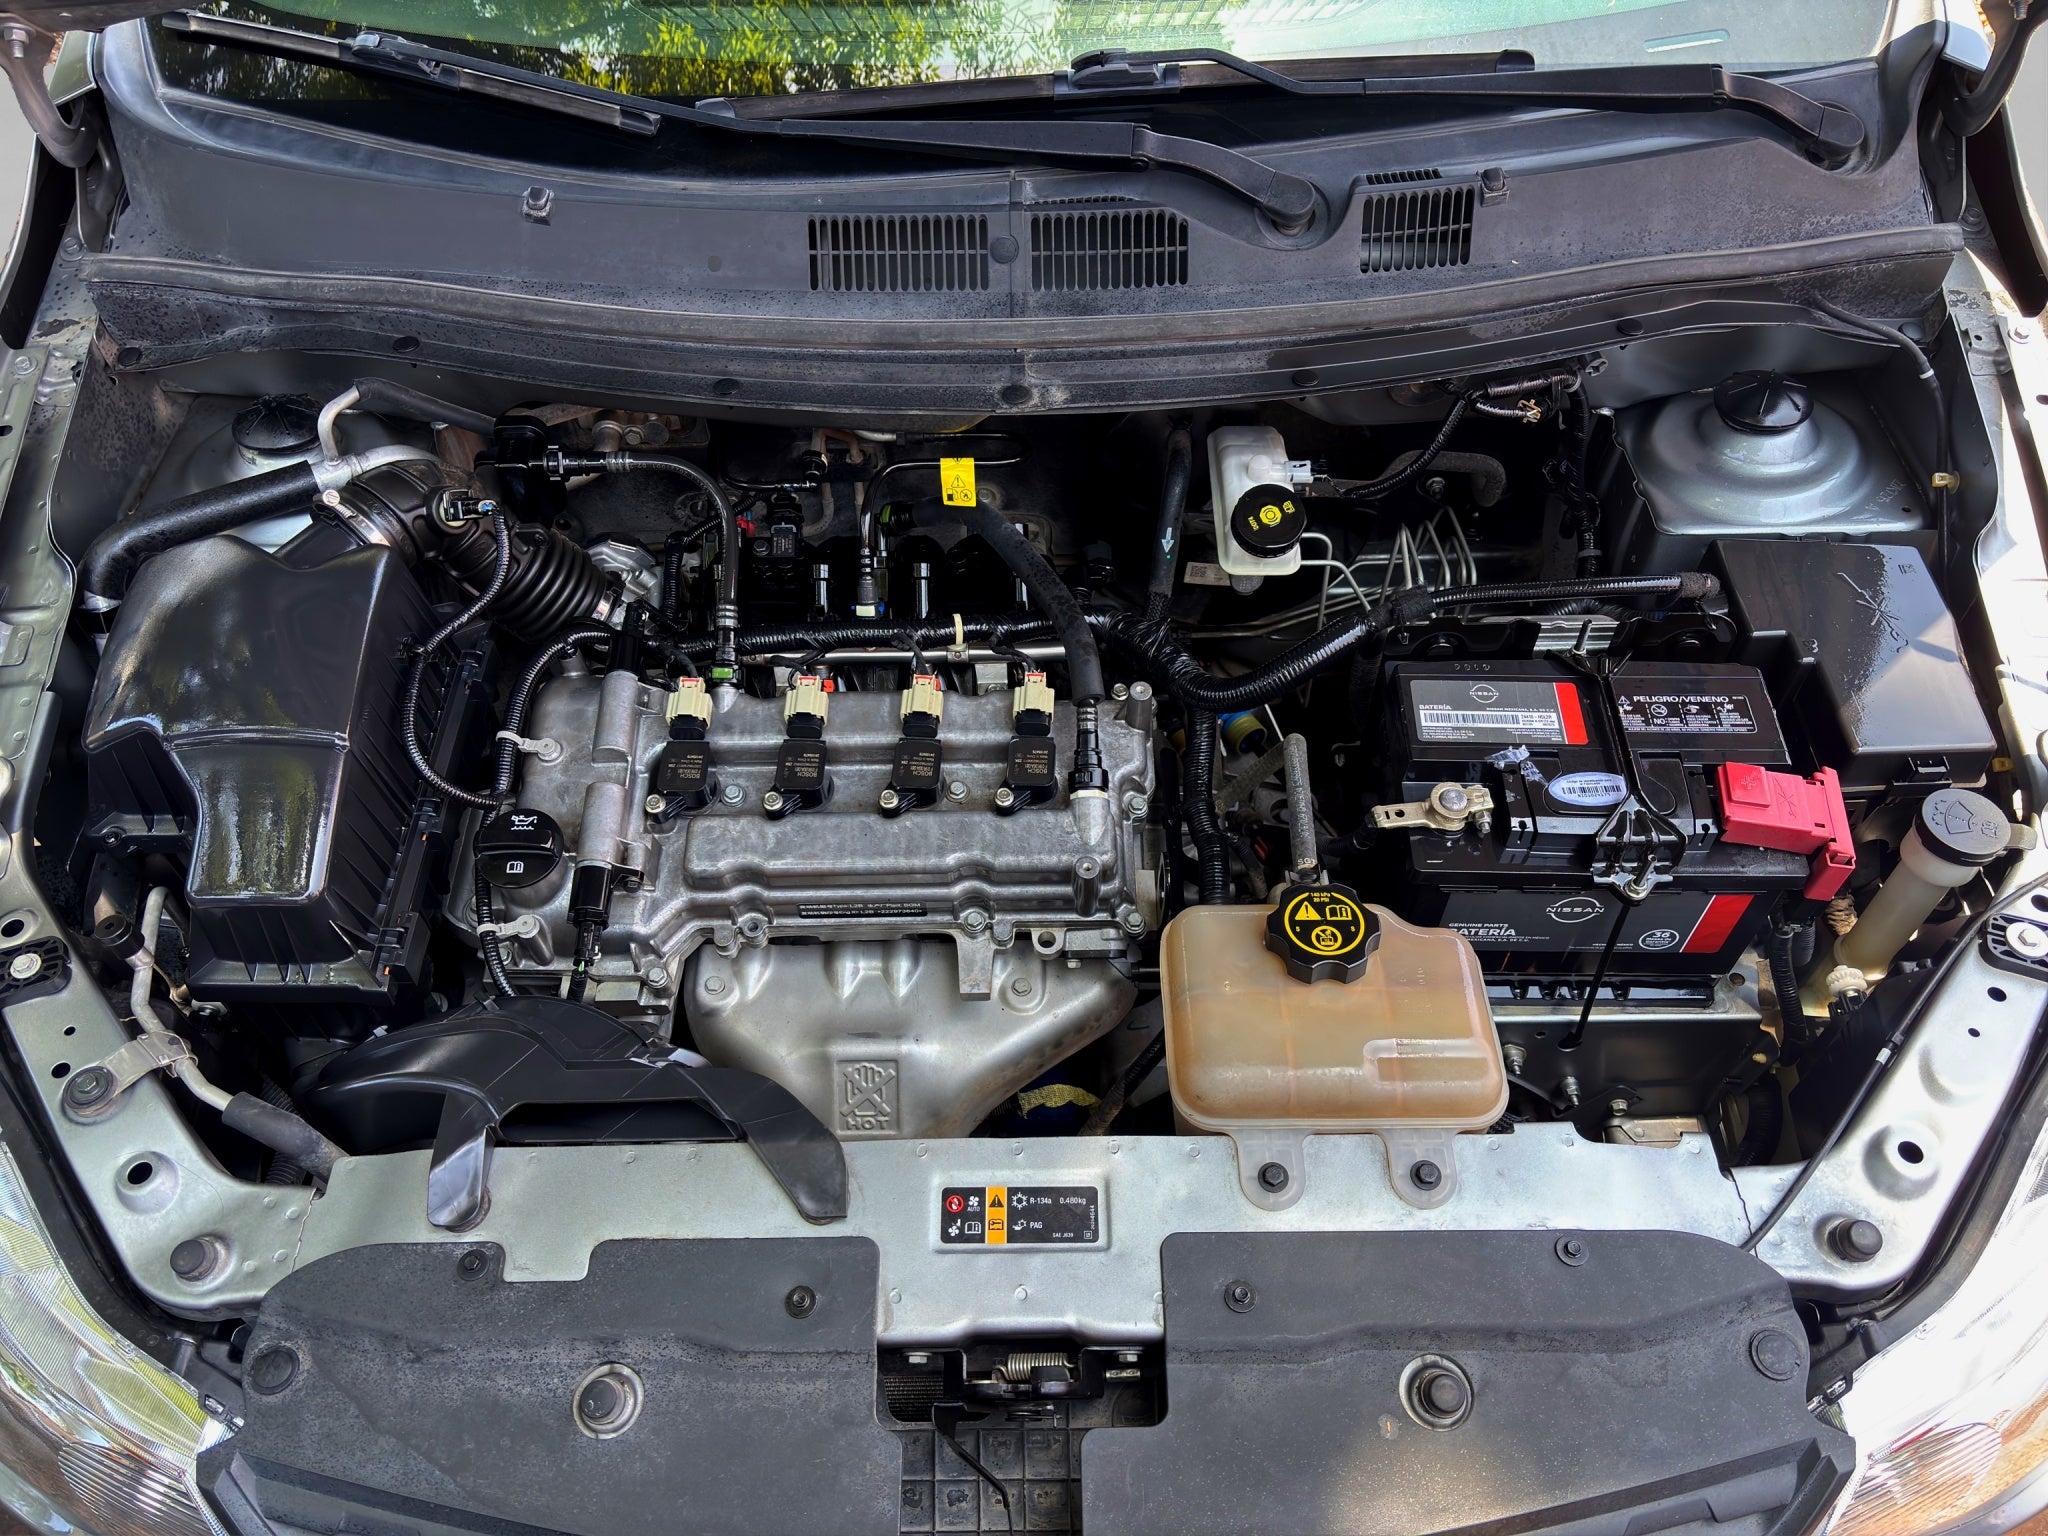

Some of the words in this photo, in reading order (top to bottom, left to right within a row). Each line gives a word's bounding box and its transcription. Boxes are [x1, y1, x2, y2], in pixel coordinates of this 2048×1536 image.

[1633, 695, 1729, 703] PELIGRO/VENENO
[1546, 906, 1605, 914] NISSAN
[846, 1116, 890, 1131] HOT
[1029, 1221, 1043, 1229] PAG
